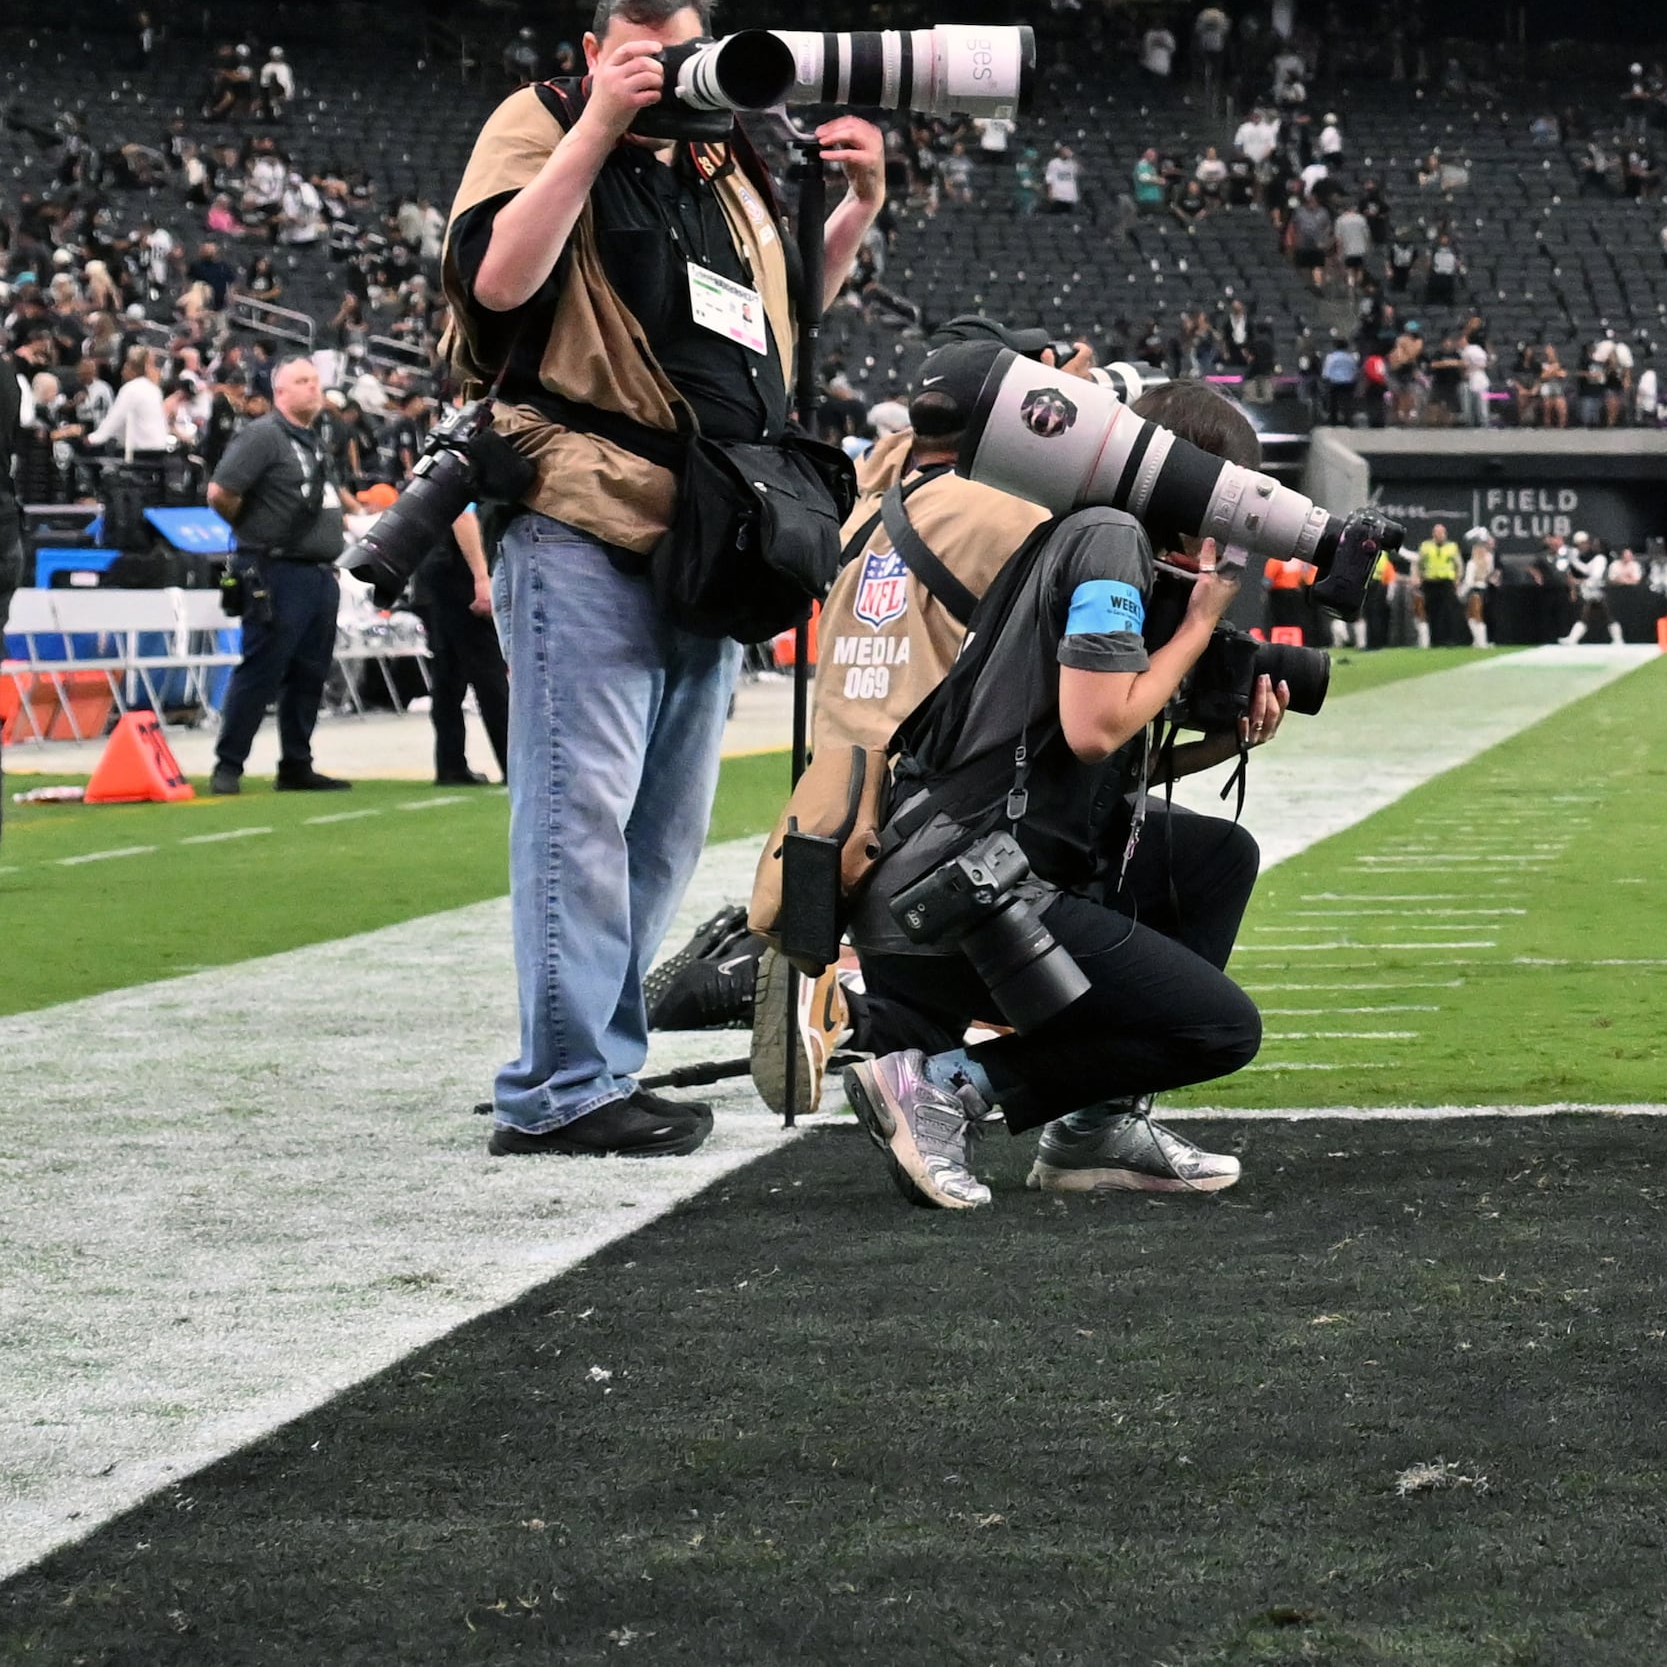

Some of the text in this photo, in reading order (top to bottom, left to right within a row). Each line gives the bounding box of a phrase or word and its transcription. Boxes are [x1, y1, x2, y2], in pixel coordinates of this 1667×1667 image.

[1487, 489, 1578, 512] FIELD
[1490, 515, 1572, 539] CLUB
[860, 579, 901, 618] NFL
[1110, 594, 1138, 615] WEEK
[833, 636, 910, 665] MEDIA
[843, 666, 890, 699] 069
